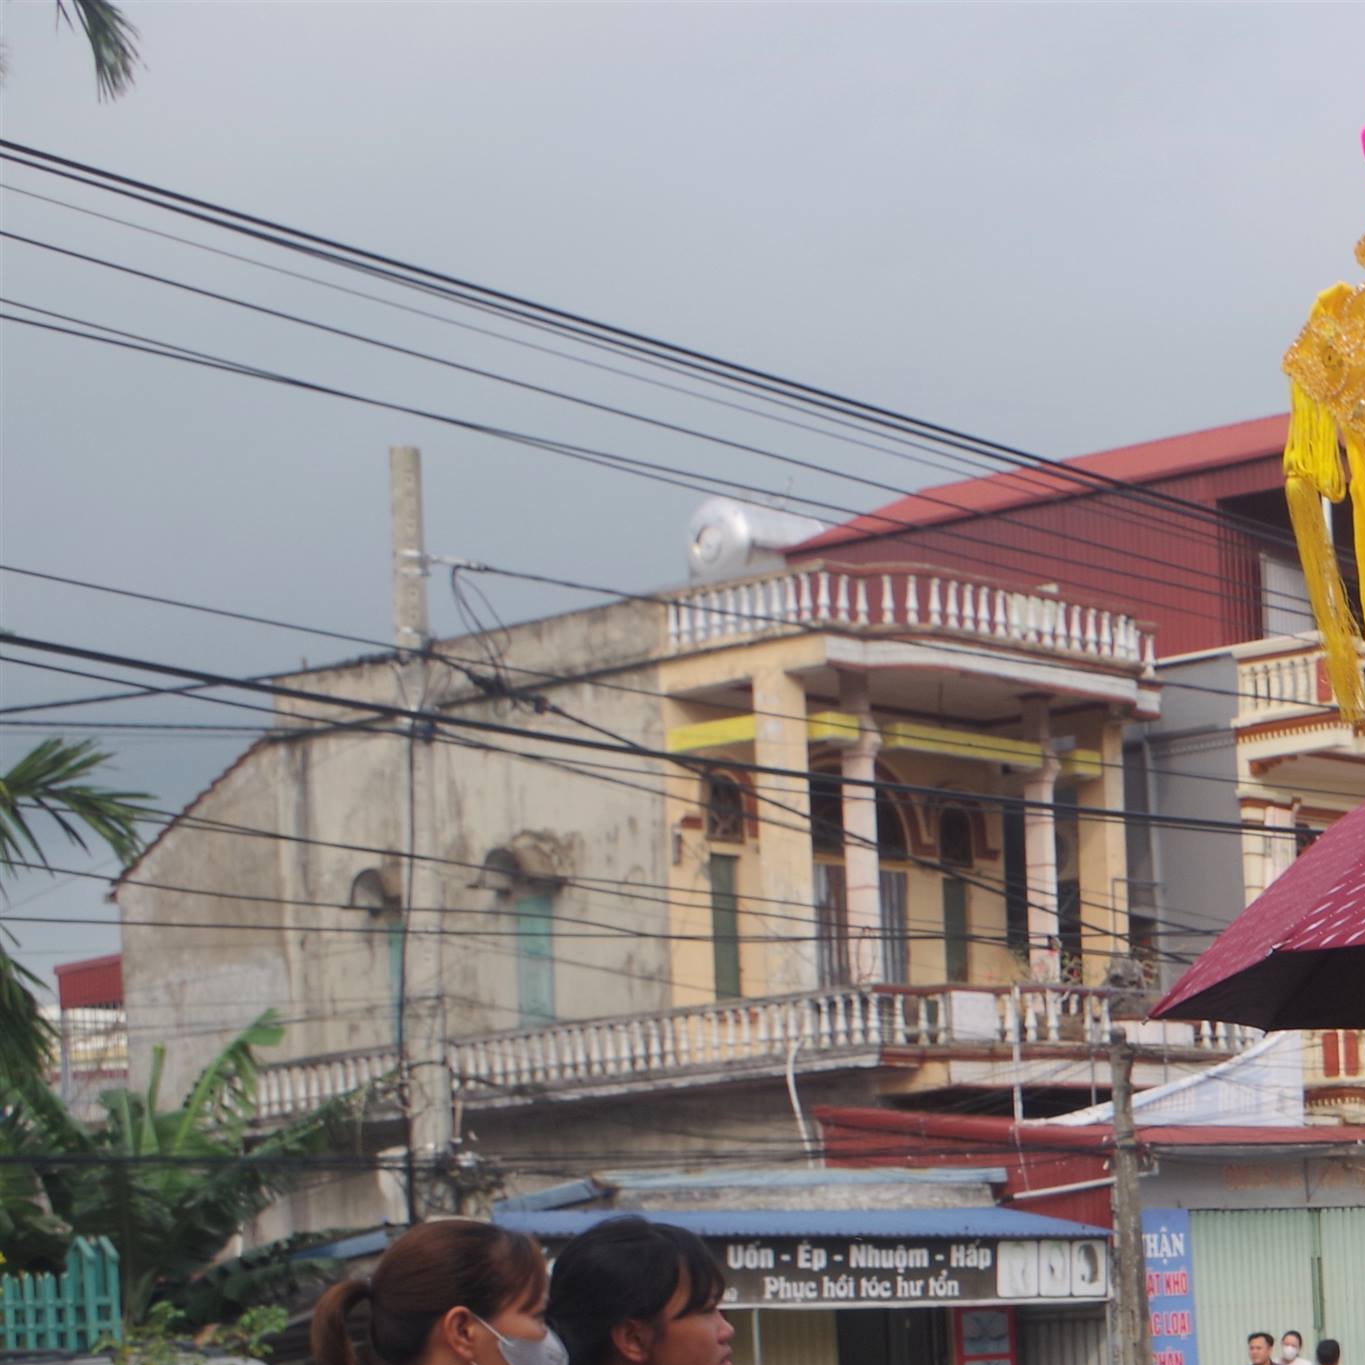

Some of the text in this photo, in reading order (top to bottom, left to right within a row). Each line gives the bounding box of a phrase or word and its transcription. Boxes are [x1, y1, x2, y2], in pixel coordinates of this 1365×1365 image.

[727, 1238, 992, 1274] Uốn Ép Nhuộm Hấp
[763, 1275, 818, 1302] Phục
[822, 1272, 854, 1299] hồi
[860, 1274, 892, 1299] tóc
[896, 1275, 923, 1298] hư
[928, 1268, 959, 1298] tổn
